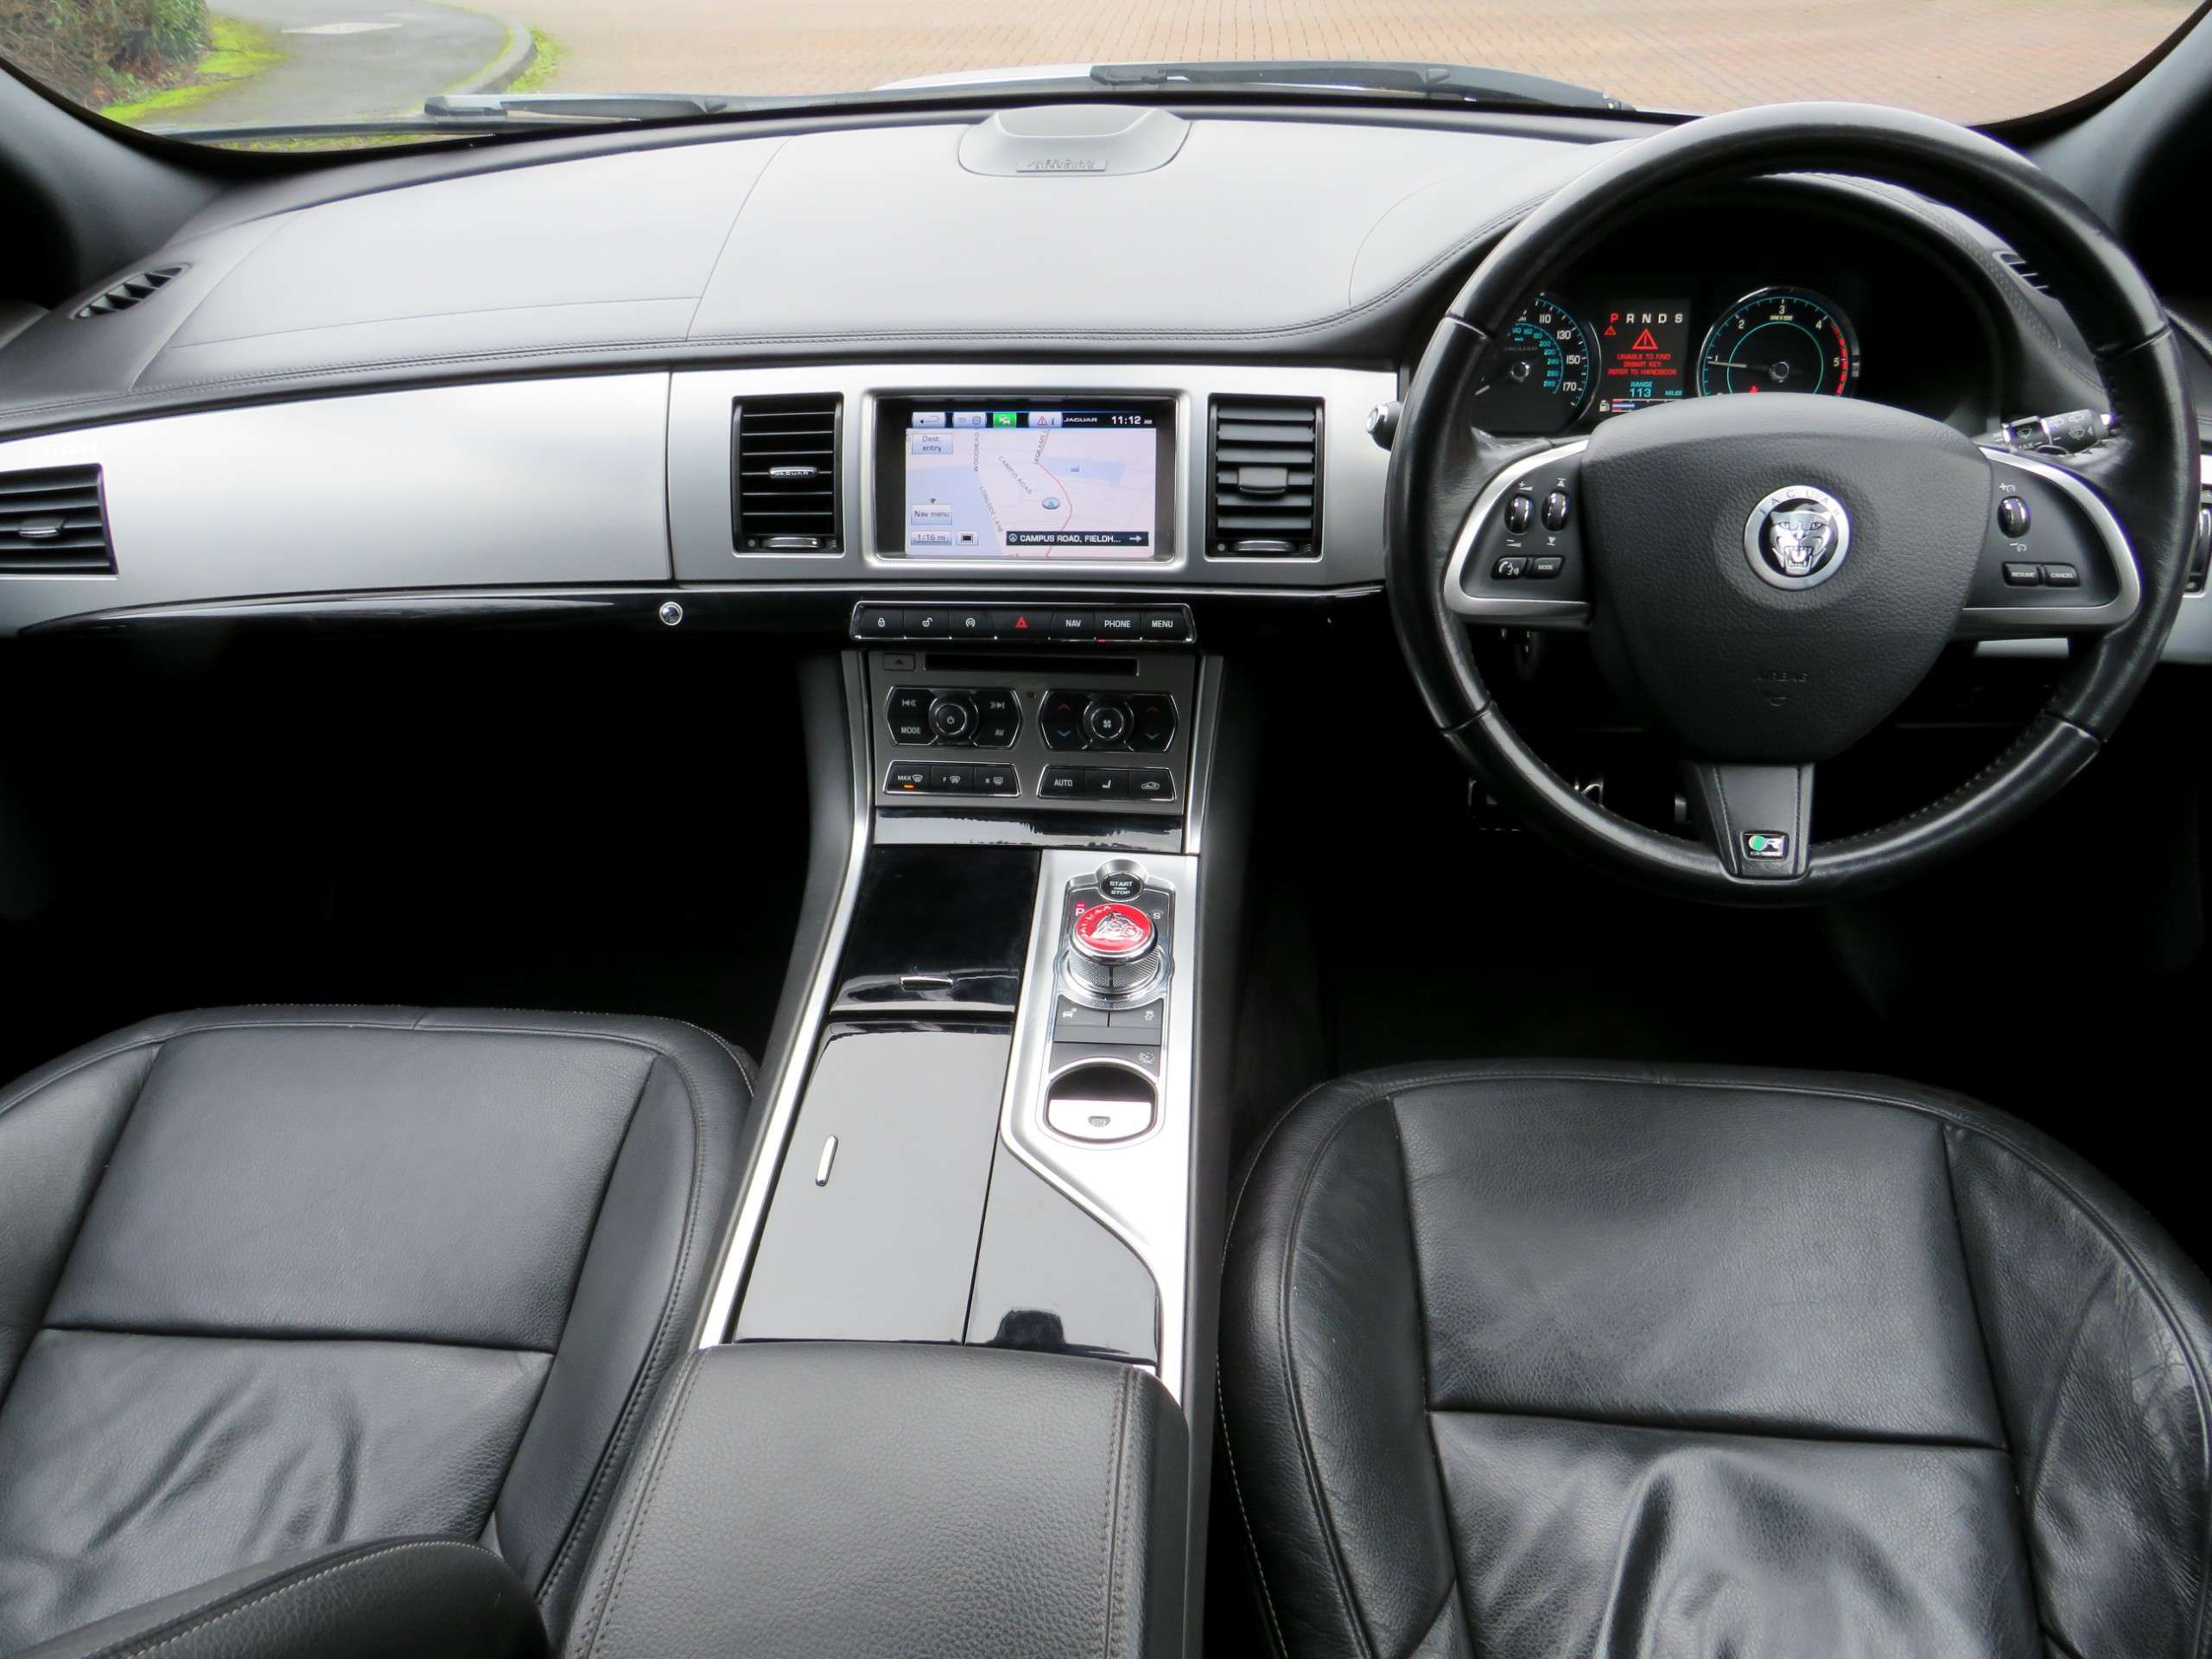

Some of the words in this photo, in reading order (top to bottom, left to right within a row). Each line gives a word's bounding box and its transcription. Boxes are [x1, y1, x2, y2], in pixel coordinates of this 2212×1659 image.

[1779, 305, 1785, 314] 3
[1539, 314, 1551, 324] 110
[1610, 313, 1618, 323] P
[1625, 313, 1635, 324] R
[1642, 313, 1651, 323] N
[1657, 313, 1668, 324] D
[1675, 313, 1683, 323] S
[1738, 320, 1745, 329] 2
[1815, 321, 1822, 329] 4
[1556, 330, 1571, 340] 130
[1566, 354, 1580, 365] 150
[1833, 357, 1840, 367] 5
[1562, 382, 1577, 391] 170
[1630, 388, 1651, 397] 113
[1111, 416, 1141, 425] 11:12
[1020, 534, 1054, 543] CAMPUS
[1065, 619, 1081, 628] NAV
[1104, 619, 1130, 628] PHONE
[1152, 619, 1173, 628] MENU
[900, 726, 921, 734] MODE
[1054, 779, 1073, 788] AUTO
[1075, 907, 1085, 917] P
